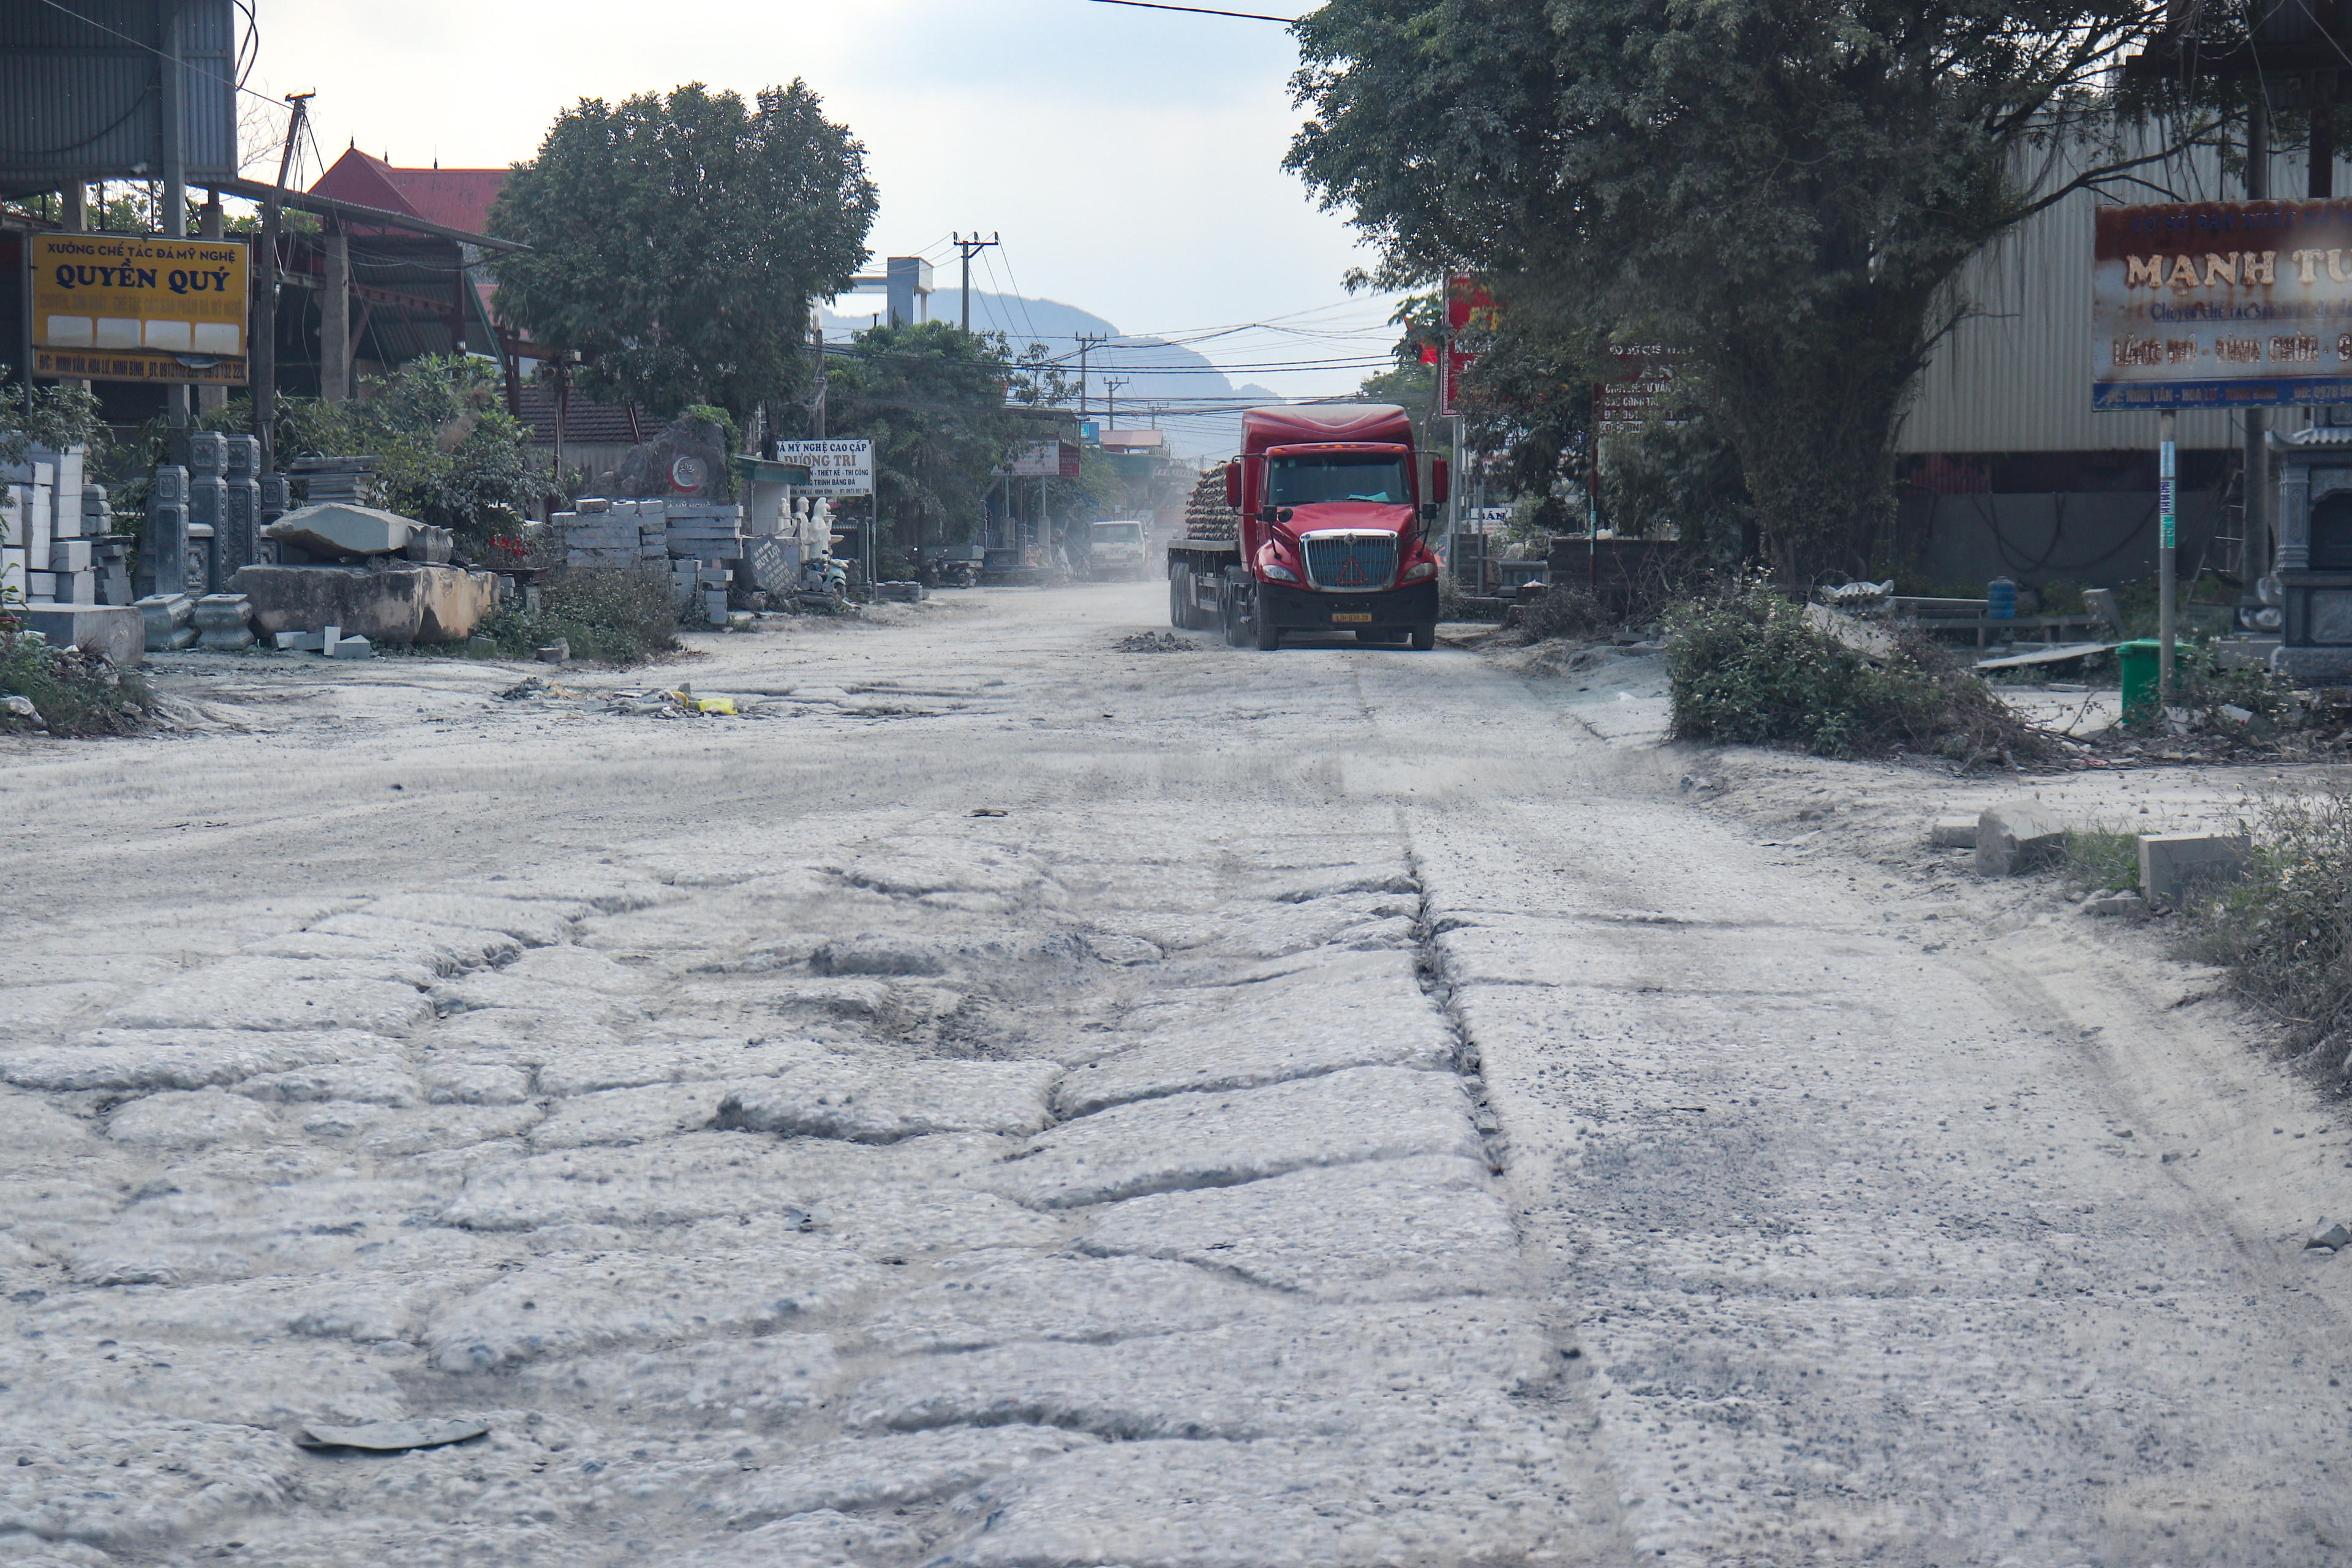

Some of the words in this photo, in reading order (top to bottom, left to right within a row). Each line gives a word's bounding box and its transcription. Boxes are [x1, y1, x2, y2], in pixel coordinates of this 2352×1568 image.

[98, 241, 124, 257] CHẾ
[127, 244, 153, 258] TÁC
[157, 246, 174, 259] ĐÁ
[176, 247, 197, 260] MỸ
[200, 249, 236, 264] NGHỆ
[168, 266, 231, 294] QUÝ
[2127, 250, 2277, 295] MẠNH
[2182, 388, 2202, 401] HOA
[788, 442, 801, 452] MỸ
[803, 441, 827, 453] NGHỆ
[830, 443, 848, 452] CAO
[850, 440, 867, 452] CẤP
[818, 467, 832, 476] THIẾT
[834, 467, 840, 476] KẾ
[848, 477, 856, 486] ĐÁ
[755, 553, 769, 570] HUY
